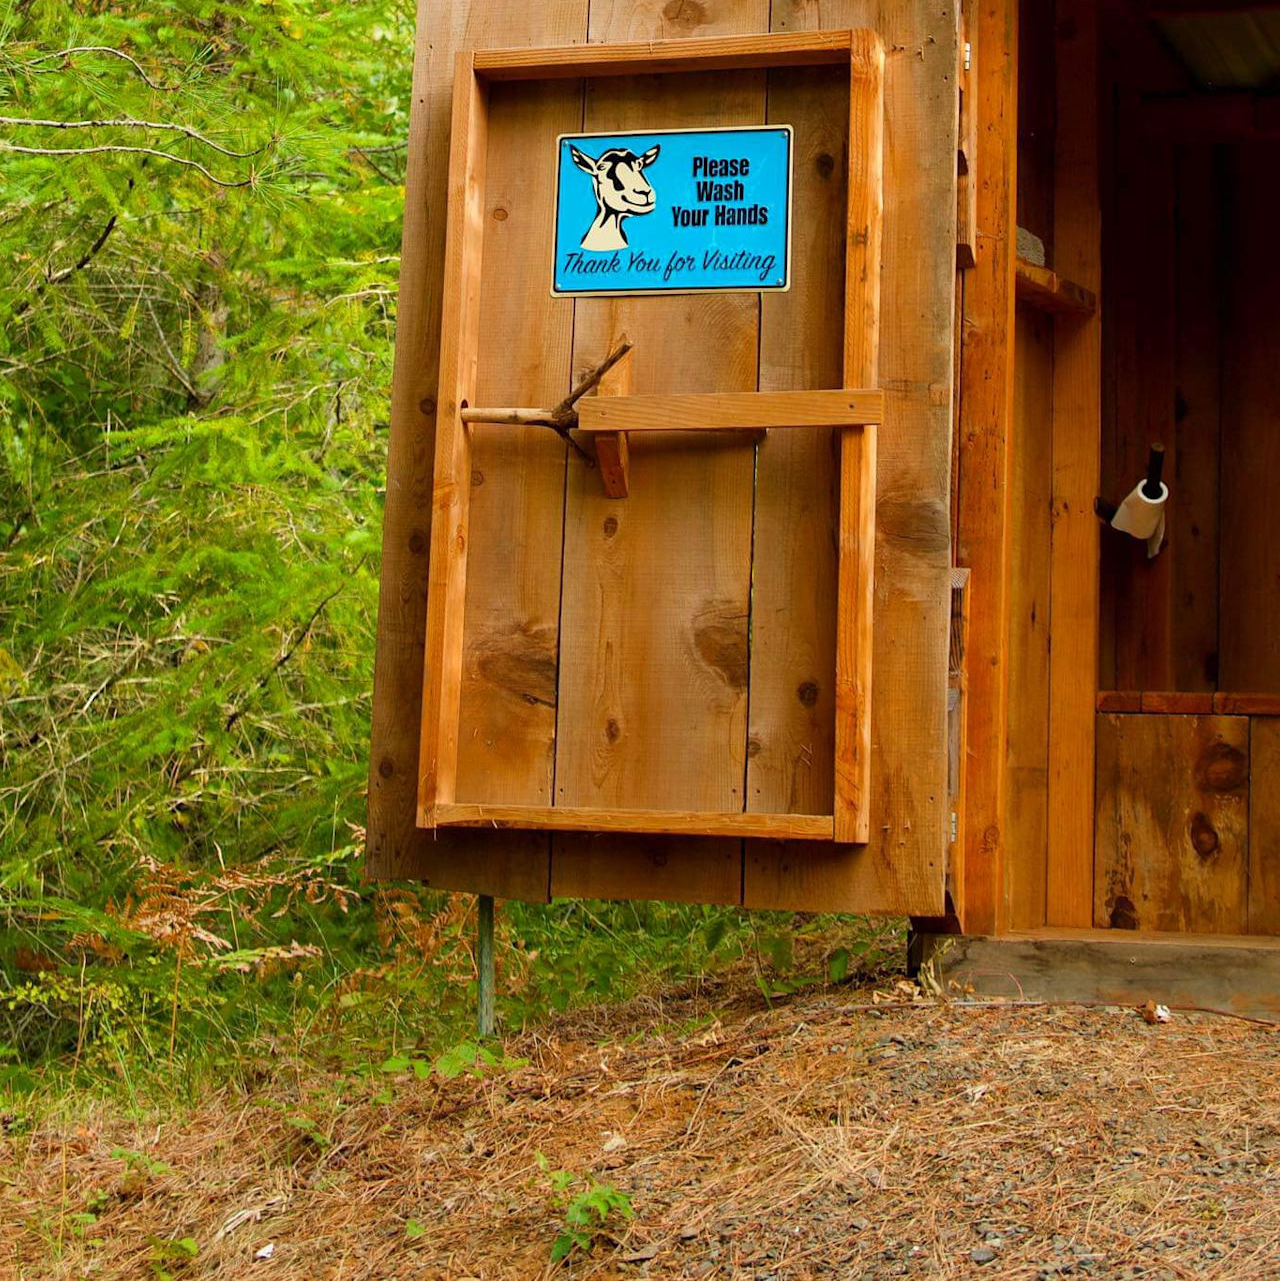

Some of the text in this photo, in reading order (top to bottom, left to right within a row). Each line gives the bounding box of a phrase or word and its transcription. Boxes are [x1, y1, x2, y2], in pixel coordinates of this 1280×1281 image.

[692, 156, 749, 178] Please
[696, 180, 744, 202] Wash
[672, 204, 768, 227] Your Hands
[563, 249, 776, 281] Thank You for Visiting
